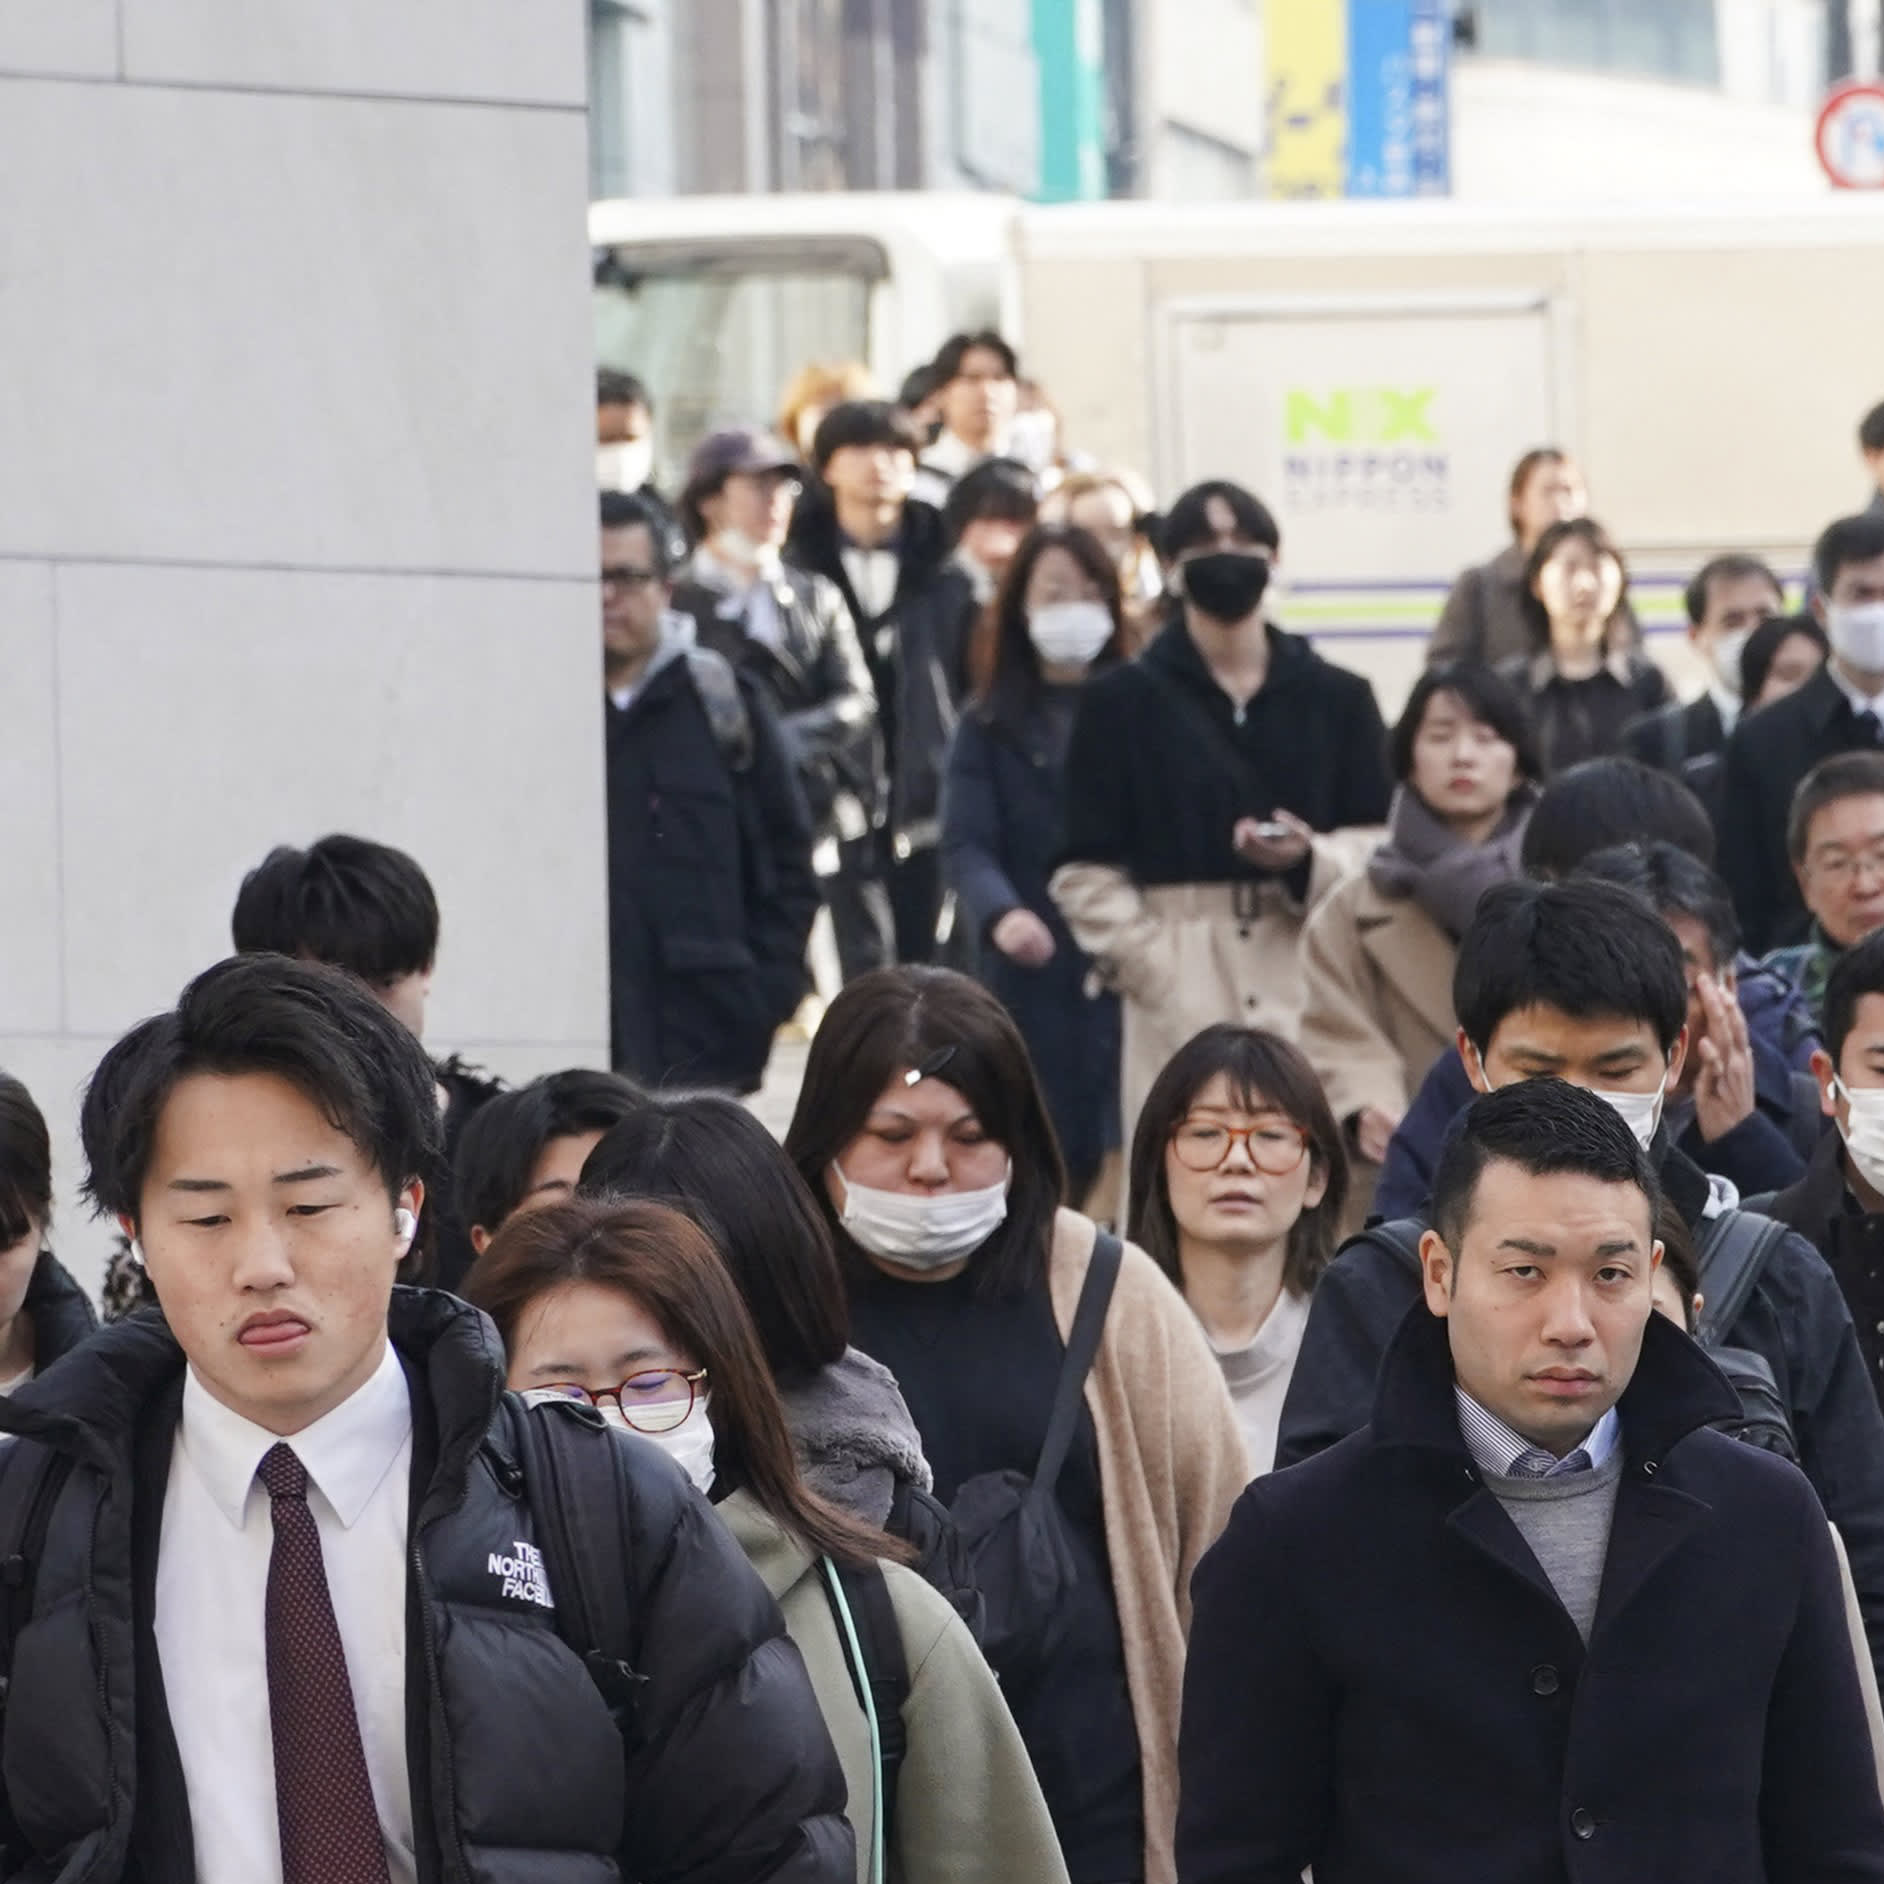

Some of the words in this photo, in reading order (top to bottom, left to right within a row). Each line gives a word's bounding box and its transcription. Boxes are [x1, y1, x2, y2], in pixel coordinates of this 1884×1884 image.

[1284, 453, 1449, 484] NIPPON
[513, 1541, 542, 1566] THE
[502, 1577, 547, 1606] FACE
